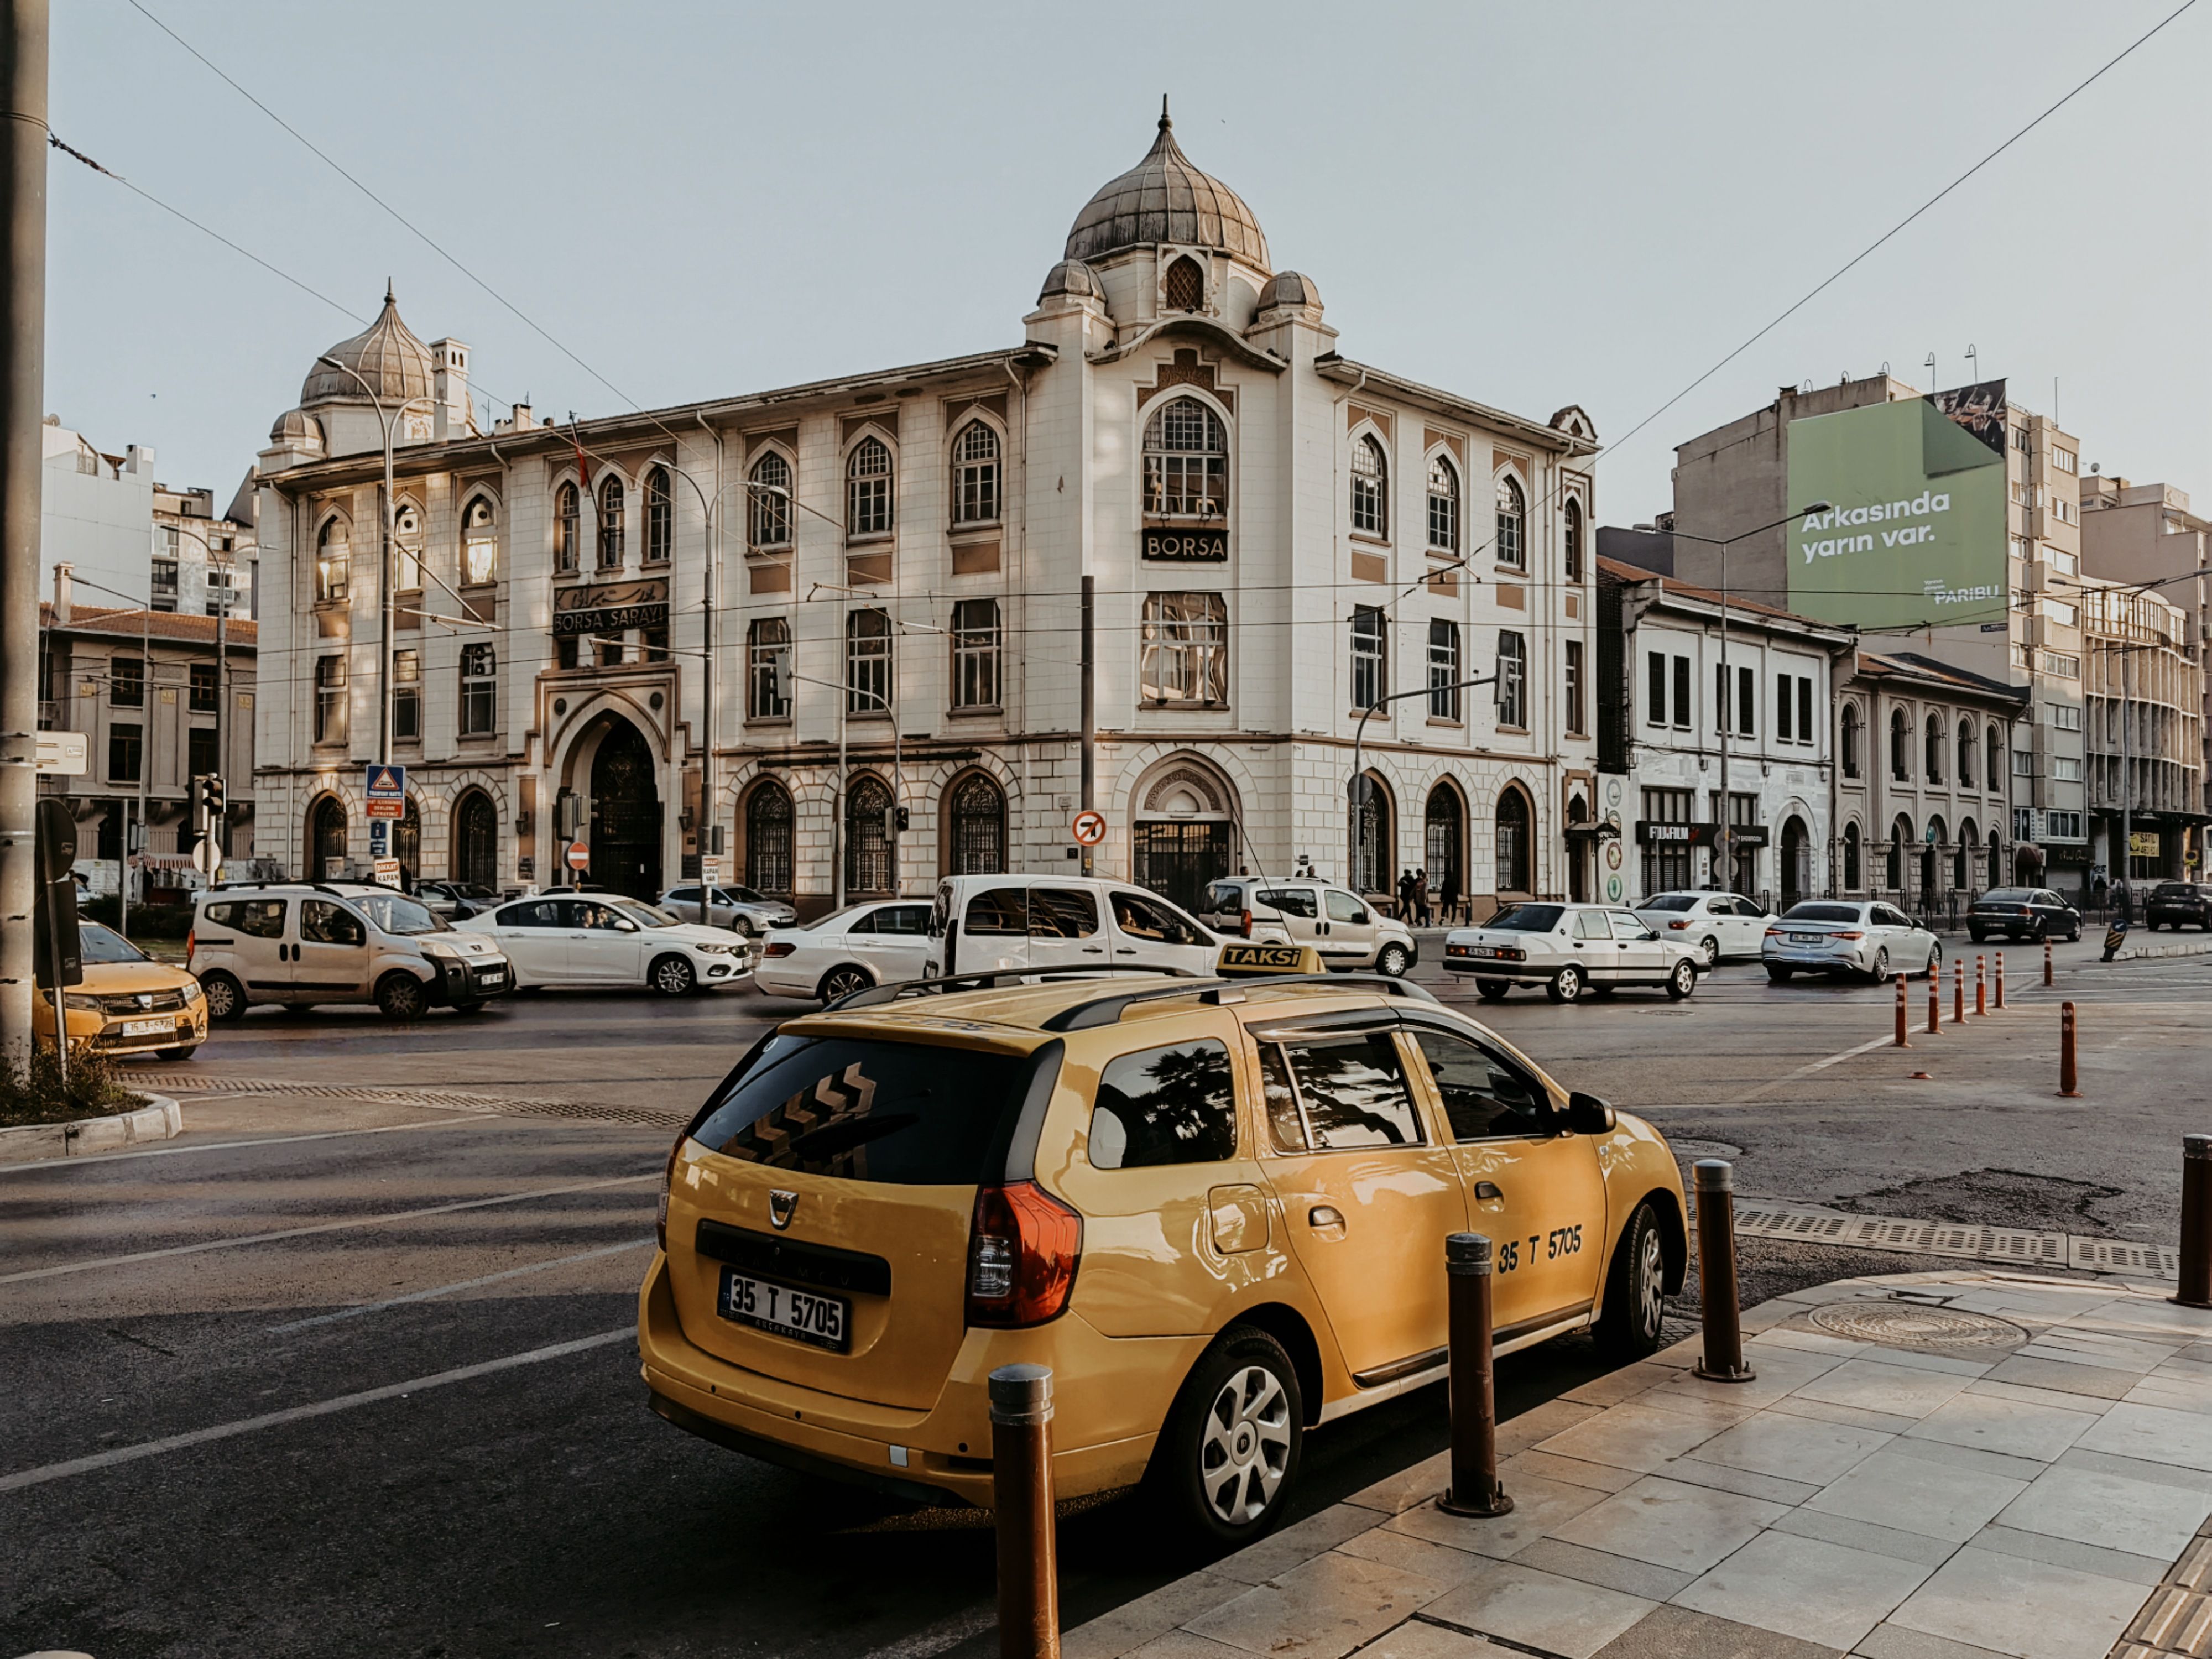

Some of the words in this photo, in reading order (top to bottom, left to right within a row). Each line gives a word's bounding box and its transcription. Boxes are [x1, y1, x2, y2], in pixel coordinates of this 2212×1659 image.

[1801, 491, 1949, 533] Arkasında
[1147, 537, 1225, 556] BORSA
[1801, 534, 1873, 564] yarın
[1881, 525, 1935, 547] var.
[555, 612, 603, 632] BORSA
[610, 606, 663, 627] SARAYI
[1498, 1241, 1519, 1274] 35
[1528, 1235, 1540, 1265] T
[1548, 1224, 1582, 1259] 5705
[732, 1279, 755, 1313] 35
[768, 1286, 779, 1319] T
[791, 1293, 839, 1337] 5705
